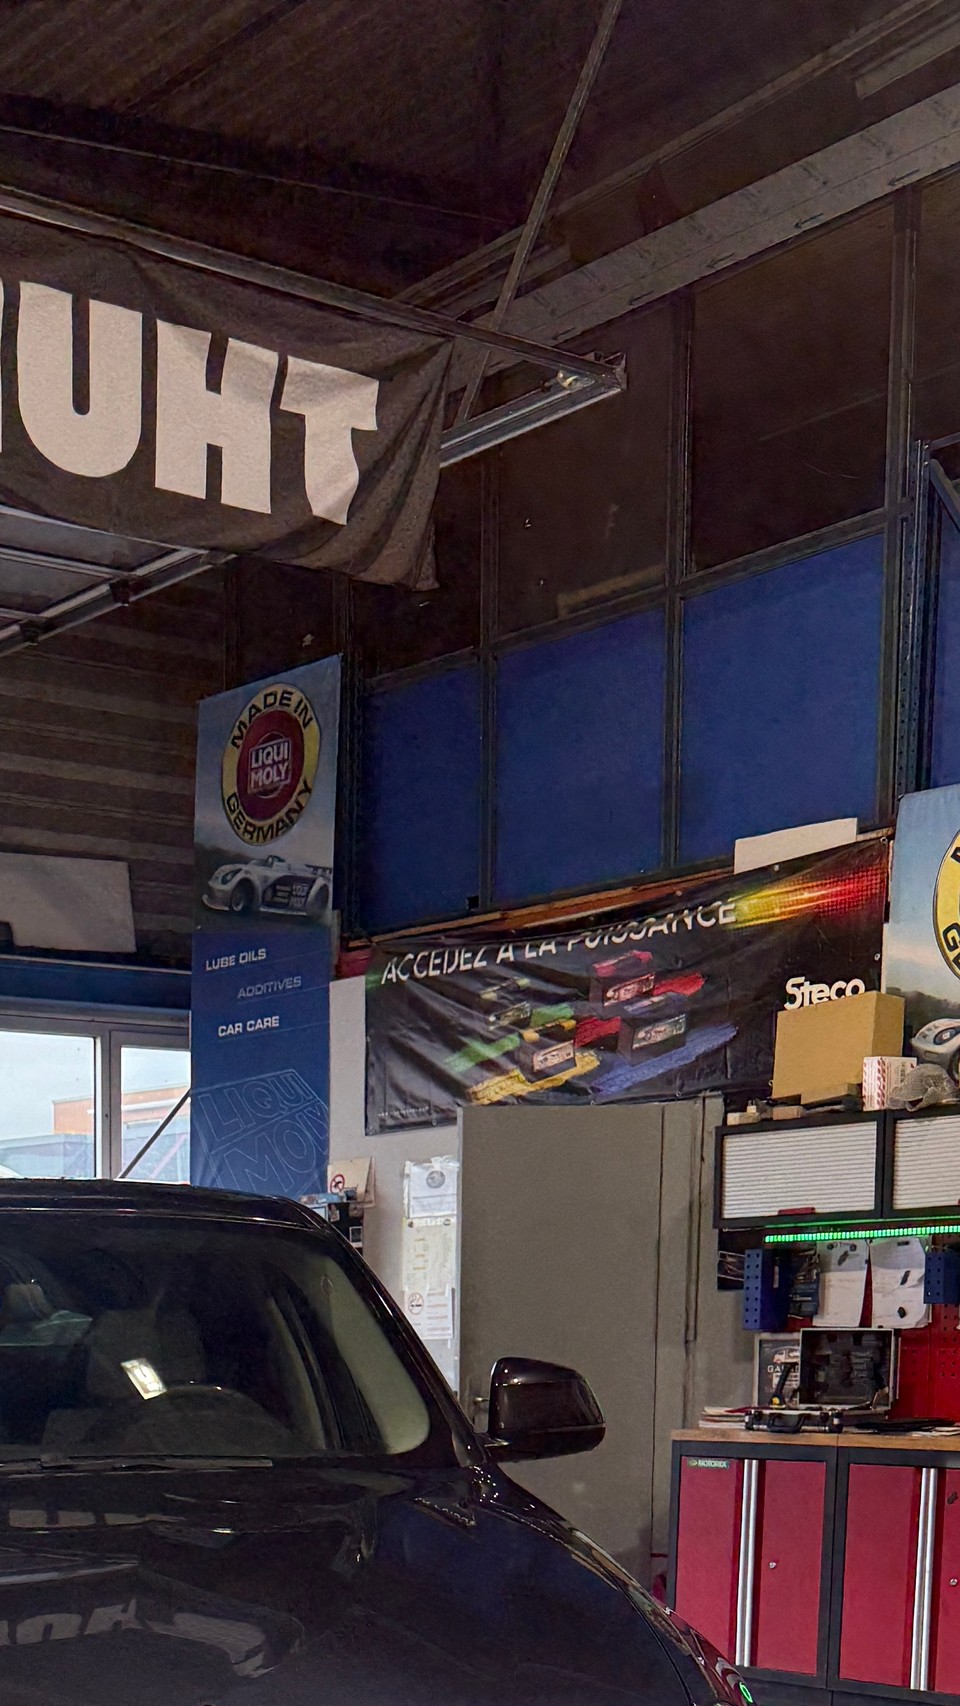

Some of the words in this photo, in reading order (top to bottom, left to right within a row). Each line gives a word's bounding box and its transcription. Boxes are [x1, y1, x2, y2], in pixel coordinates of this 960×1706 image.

[230, 689, 294, 750] MADE
[294, 697, 314, 730] IN
[251, 740, 290, 769] LIQUI
[250, 761, 290, 789] MOLY
[226, 777, 313, 843] GERMANY
[205, 954, 236, 972] LUBE
[239, 948, 267, 965] OILS
[237, 975, 302, 999] ADDITIVES
[784, 976, 866, 1011] Steco
[218, 1022, 243, 1037] CAR
[246, 1015, 280, 1032] CARE
